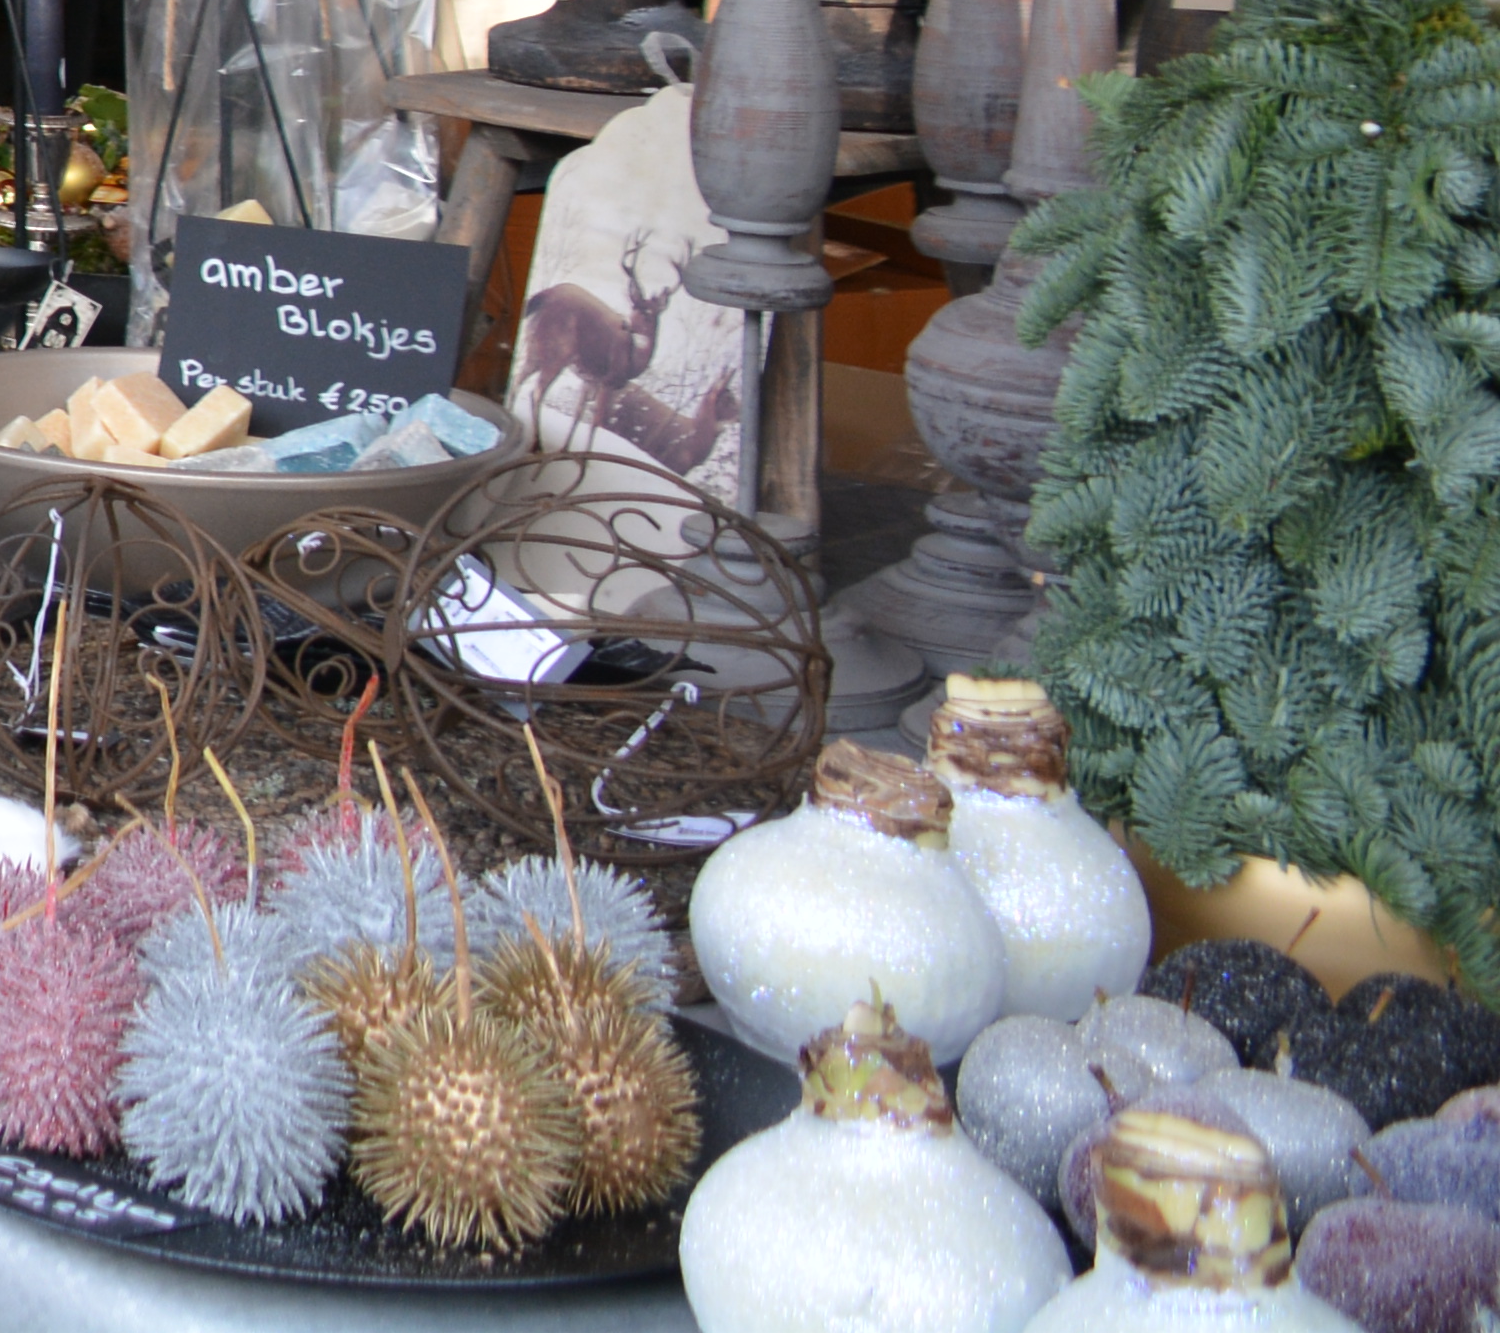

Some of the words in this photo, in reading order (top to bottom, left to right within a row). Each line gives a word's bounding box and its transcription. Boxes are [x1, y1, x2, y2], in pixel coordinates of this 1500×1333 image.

[200, 254, 343, 299] amber
[179, 359, 228, 389] Per
[234, 368, 308, 402] stuk
